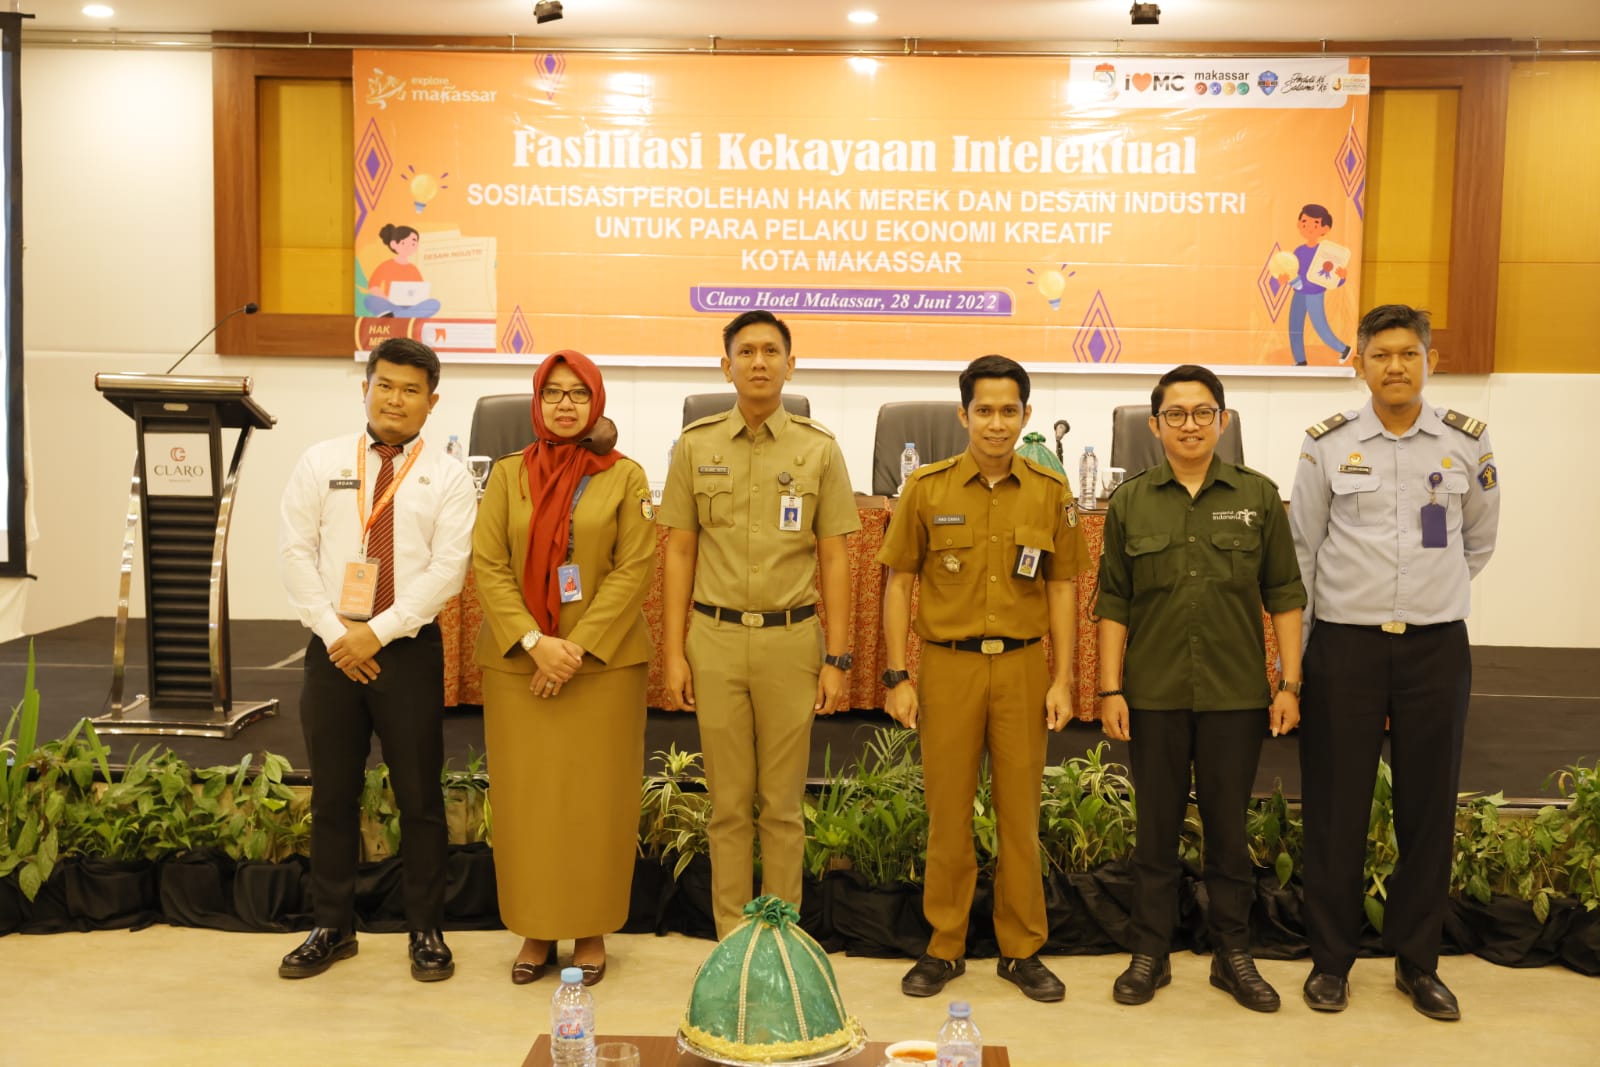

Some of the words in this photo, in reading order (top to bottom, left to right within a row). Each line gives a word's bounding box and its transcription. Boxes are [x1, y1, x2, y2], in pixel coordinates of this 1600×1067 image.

[411, 77, 449, 86] explore
[1194, 69, 1249, 81] makassar
[411, 85, 497, 104] makassar
[513, 129, 704, 170] Fasilitasi
[718, 133, 936, 176] Kekayaan
[951, 135, 1197, 174] Intelektual
[467, 183, 625, 208] SOSIALISASI
[633, 186, 789, 209] PEROLEHAN
[797, 188, 851, 210] HAK
[859, 189, 950, 211] MEREK
[958, 190, 1012, 212] DAN
[1021, 191, 1116, 213] DESAIN
[1124, 191, 1246, 215] INDUSTRI
[595, 216, 683, 239] UNTUK
[690, 218, 759, 240] PARA
[765, 218, 867, 241] PELAKU
[876, 220, 996, 243] EKONOMI
[1004, 222, 1113, 244] KREATIF
[741, 249, 810, 271] KOTA
[817, 250, 962, 273] MAKASSAR
[706, 291, 750, 307] Claro
[755, 291, 798, 308] Hotel
[803, 293, 885, 311] Makassar,
[890, 294, 910, 309] 28
[913, 294, 952, 310] Juni
[955, 295, 998, 311] 2022
[369, 324, 390, 335] HAK
[153, 464, 204, 478] CLARO
